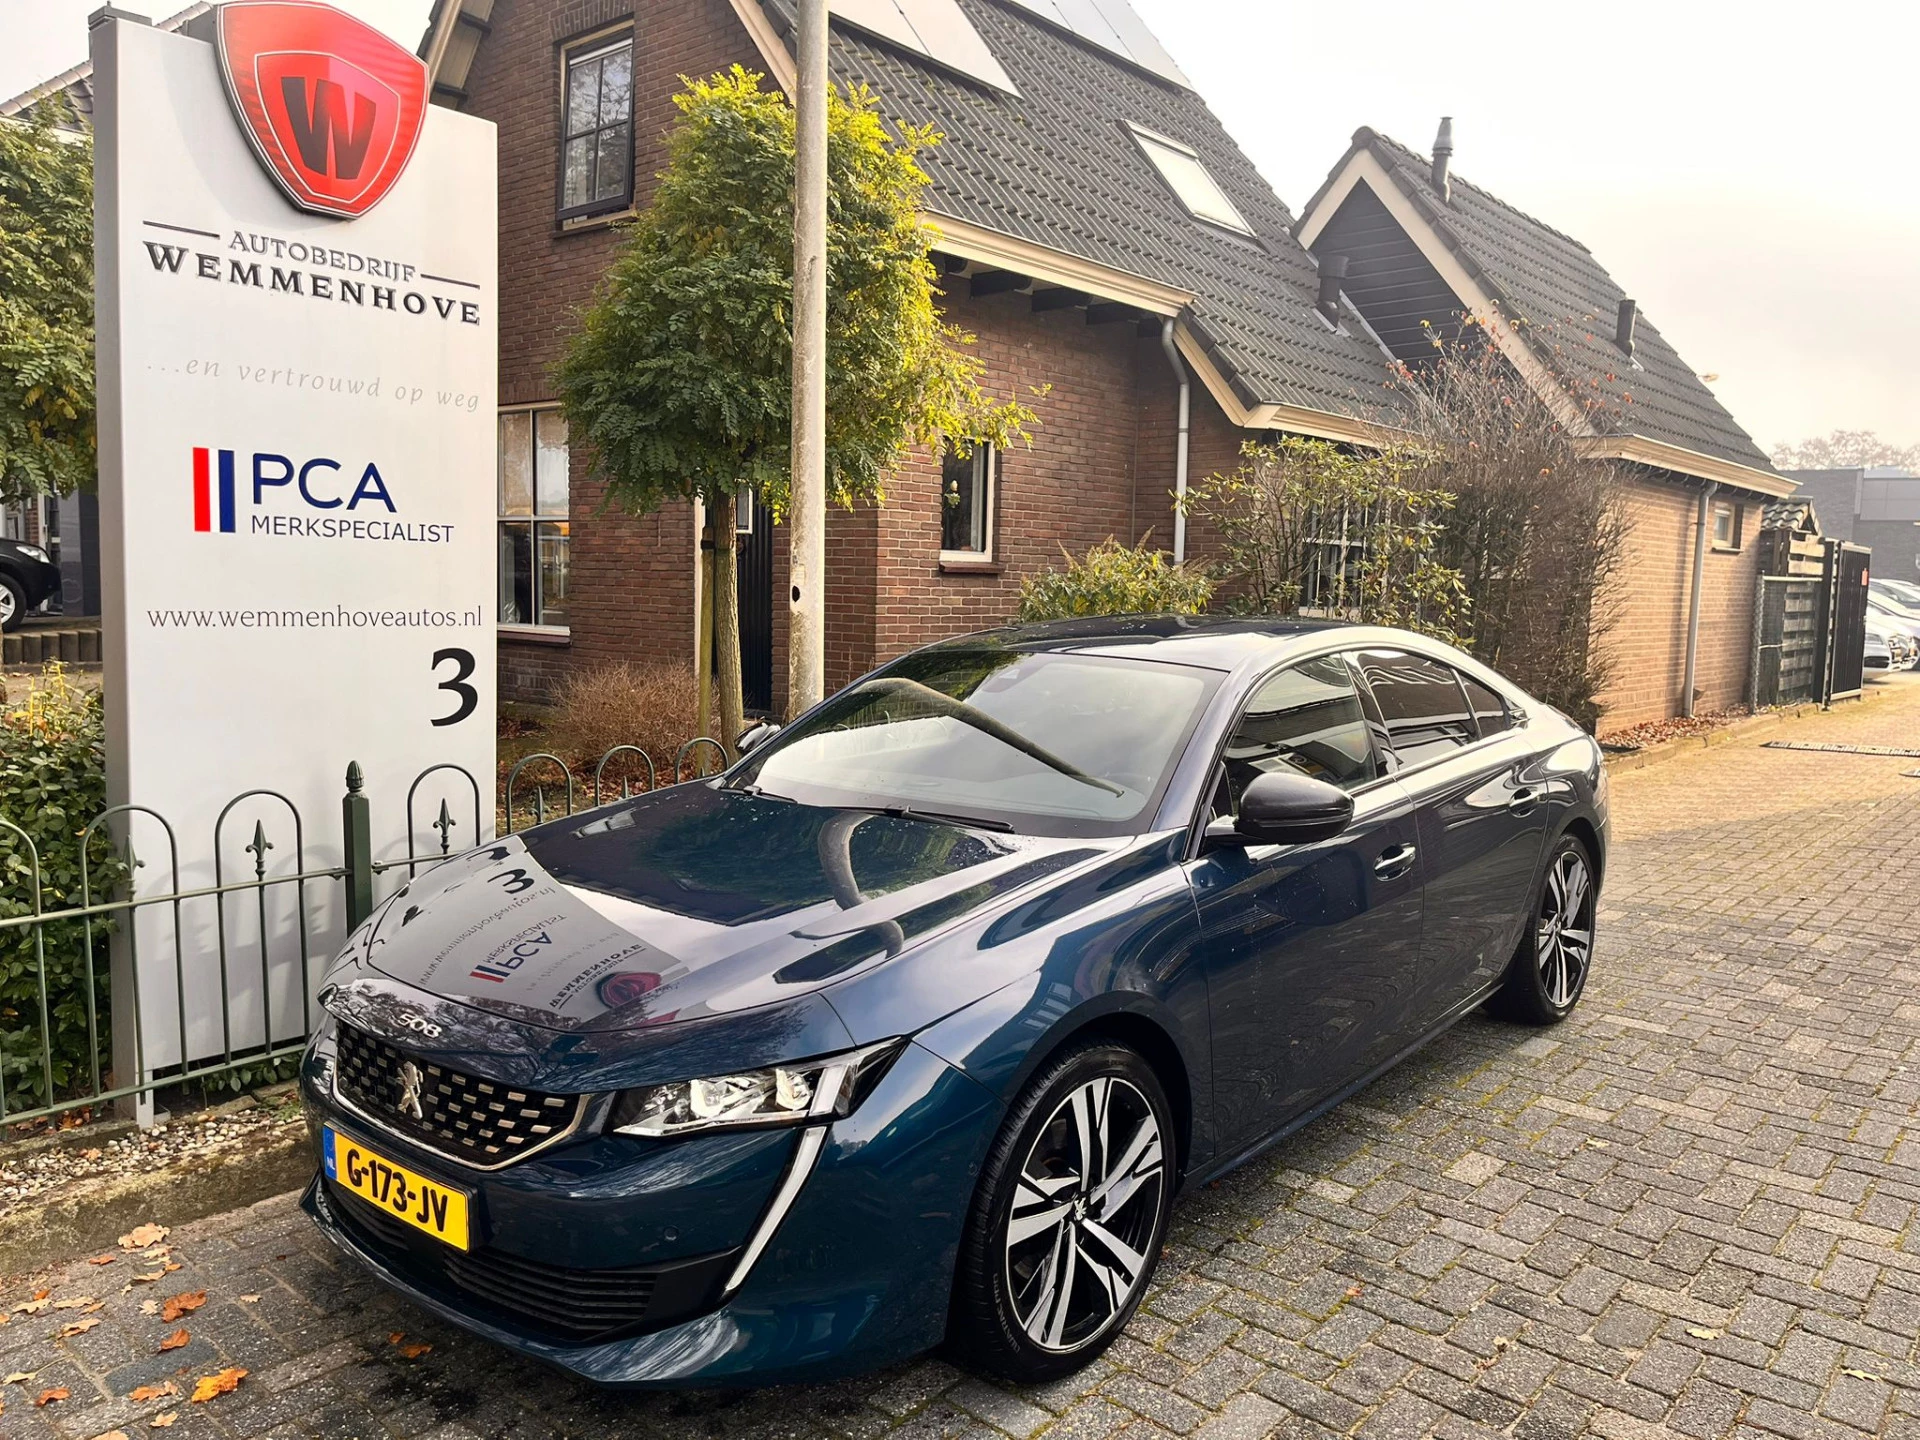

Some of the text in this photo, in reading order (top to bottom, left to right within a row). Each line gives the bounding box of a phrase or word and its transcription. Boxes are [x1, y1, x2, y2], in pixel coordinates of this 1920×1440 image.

[281, 77, 377, 180] W
[143, 240, 481, 326] WEMMENHOVE
[229, 231, 415, 283] AUTOBEDRIJF
[238, 363, 382, 398] vertrouwd
[394, 386, 424, 405] op
[437, 389, 480, 413] weg
[252, 453, 397, 513] PCA
[251, 515, 455, 543] MERKSPECIALIST
[147, 605, 482, 628] www.wemmenhoveautos.nl
[430, 647, 479, 727] 3
[397, 1013, 442, 1038] 508
[346, 1148, 448, 1233] G-173-JV
